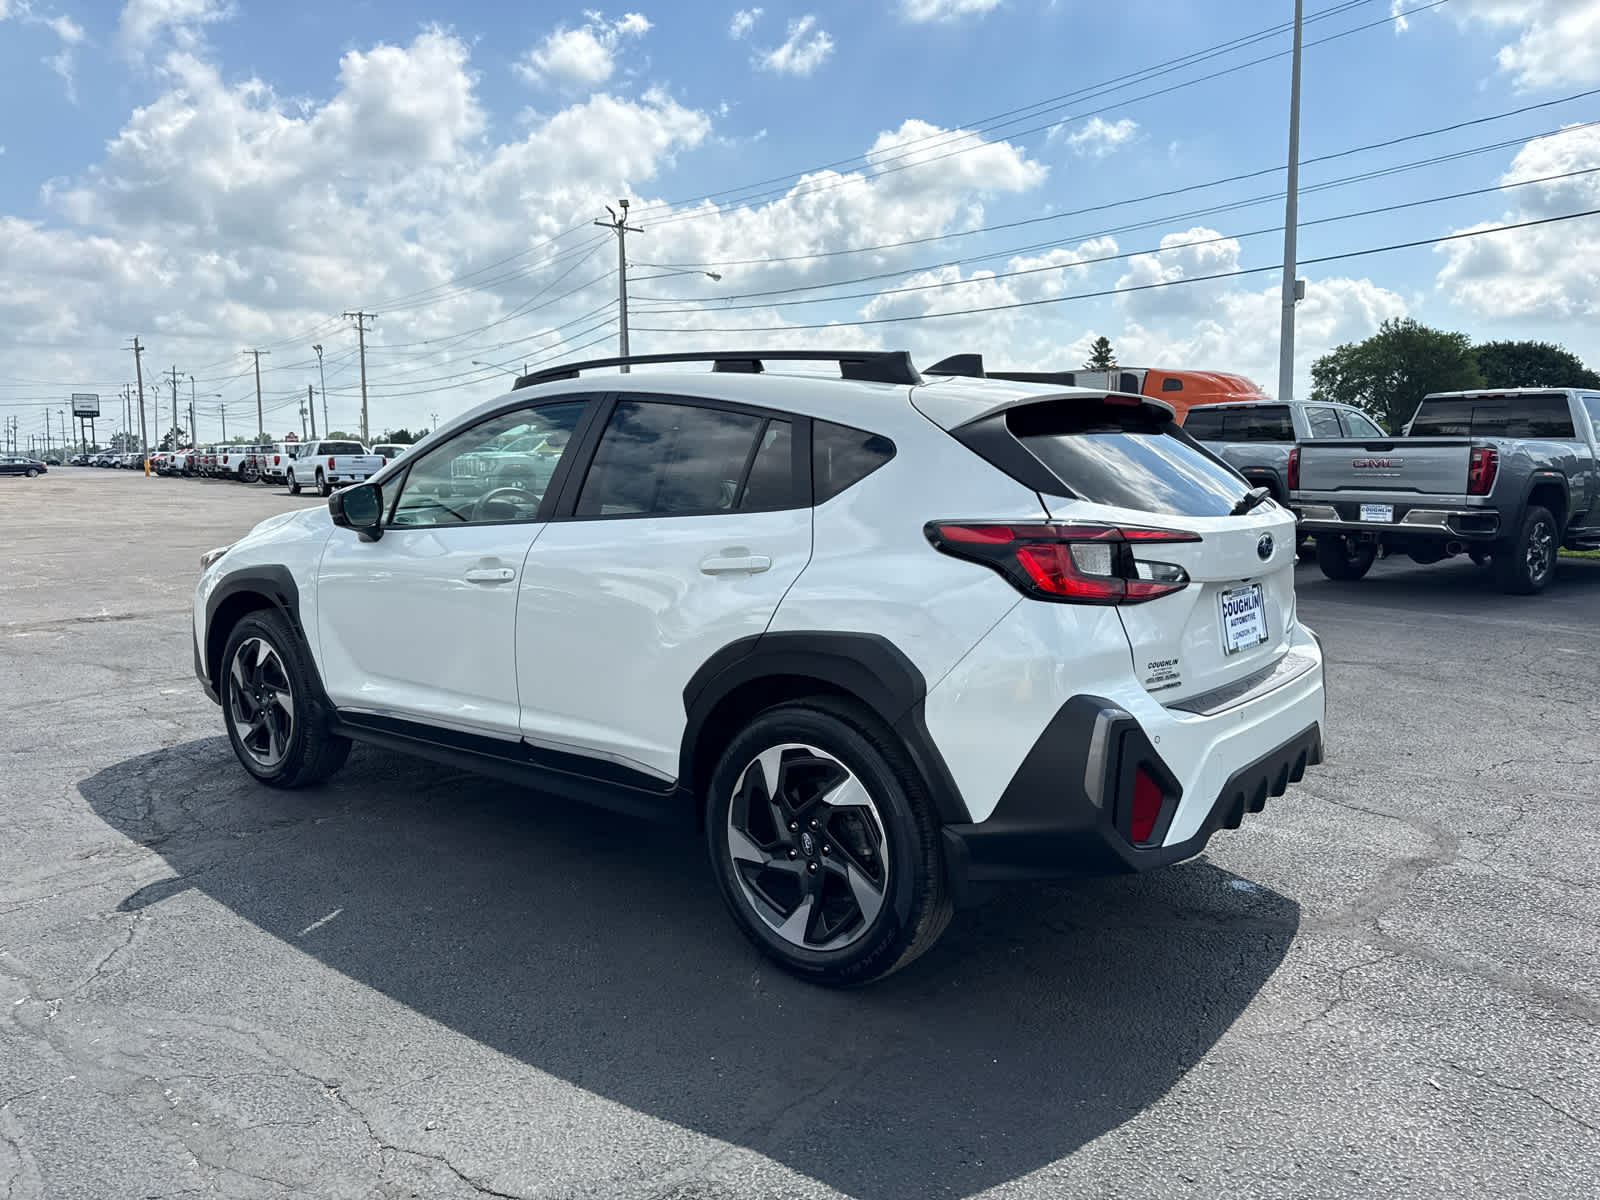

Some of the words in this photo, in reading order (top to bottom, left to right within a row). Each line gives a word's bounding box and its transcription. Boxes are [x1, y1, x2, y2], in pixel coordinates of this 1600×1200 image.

[1352, 458, 1403, 469] GMC
[1223, 594, 1260, 617] COUGHLIN
[1231, 613, 1256, 626] AUTOMOTIVE
[1147, 658, 1178, 669] COUGHLIN
